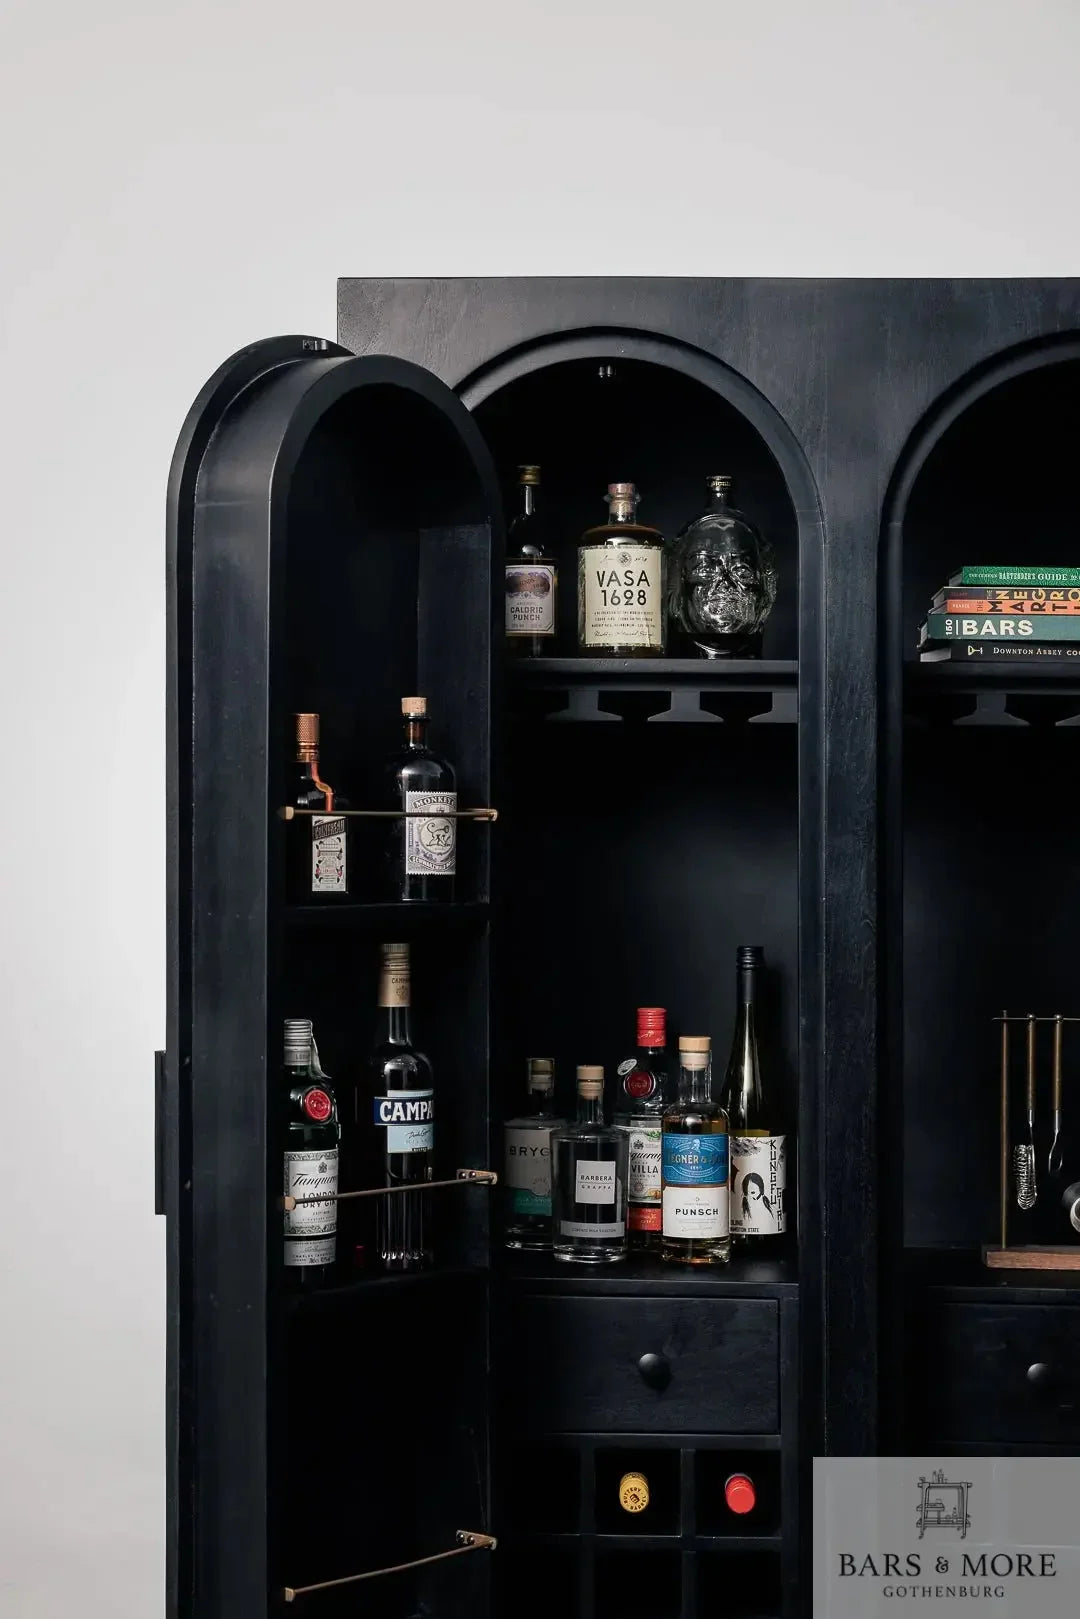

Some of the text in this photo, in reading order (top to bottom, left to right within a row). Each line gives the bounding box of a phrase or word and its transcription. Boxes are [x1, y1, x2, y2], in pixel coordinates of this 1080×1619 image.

[596, 570, 651, 588] VASA
[1037, 573, 1068, 581] GUIDE
[601, 590, 647, 607] 1628
[510, 606, 543, 614] CALORIC
[976, 601, 984, 612] THE
[945, 619, 1033, 636] 150 BARS
[993, 647, 1034, 656] DOWNTON
[1036, 648, 1062, 656] ABBEY
[415, 796, 455, 808] MONKEY
[509, 1145, 551, 1157] BRYG
[675, 1208, 719, 1216] PUNSCH
